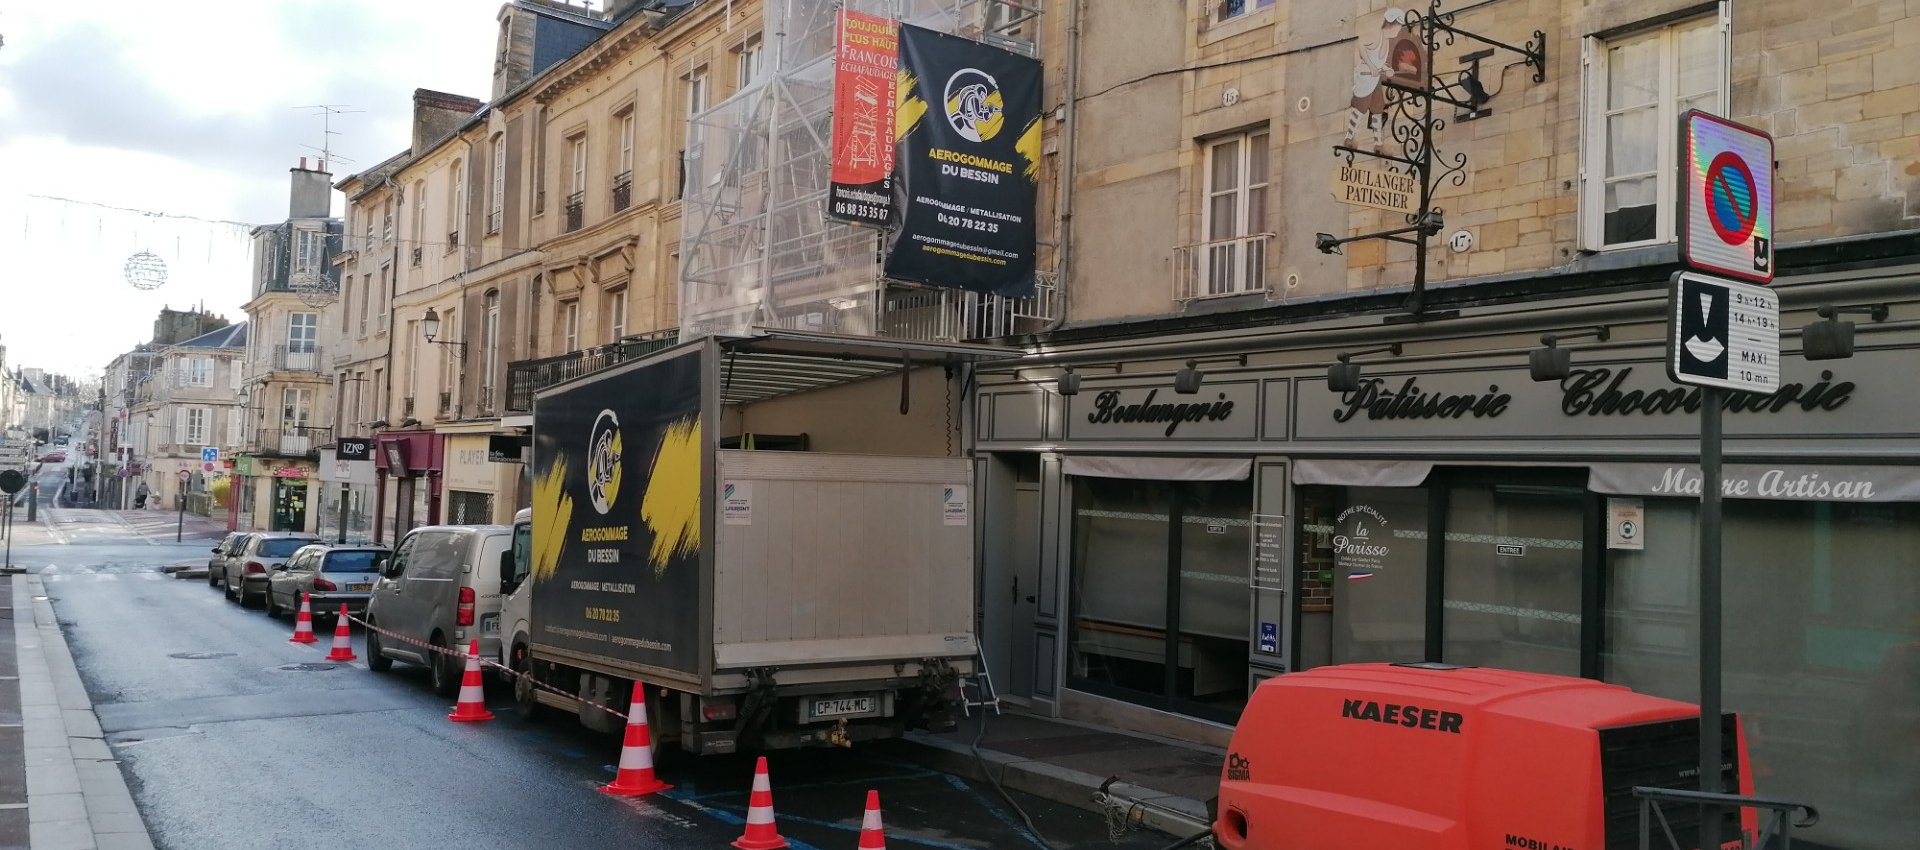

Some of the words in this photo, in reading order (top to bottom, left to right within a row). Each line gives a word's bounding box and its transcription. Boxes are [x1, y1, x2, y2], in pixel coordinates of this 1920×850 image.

[844, 32, 869, 45] PLUS
[872, 37, 898, 51] HAUT
[840, 62, 897, 80] ECHAFAUDAGES
[883, 80, 896, 189] ECHAFAUDAGES
[928, 148, 1013, 174] AEROGOMMAGE
[942, 164, 959, 176] DU
[960, 167, 999, 185] BESSIN
[1340, 166, 1414, 194] BOULANGER
[1346, 185, 1408, 210] PATISSIER
[835, 201, 846, 214] 06
[847, 203, 857, 216] 88
[857, 204, 868, 217] 35
[868, 206, 878, 219] 35
[879, 208, 888, 220] 87
[970, 207, 1022, 223] METALLISATION
[948, 215, 960, 227] 20
[961, 218, 973, 229] 78
[974, 221, 986, 232] 22
[987, 222, 999, 234] 35
[1741, 350, 1767, 365] MAXI
[1740, 370, 1752, 381] 10
[1754, 374, 1769, 384] mn
[1087, 389, 1235, 438] Boulangerie
[1560, 366, 1855, 416] Chocoerie
[460, 449, 484, 466] PLAYER
[1651, 467, 1748, 496] Mare
[1757, 469, 1876, 499] Artisan
[1337, 505, 1356, 523] NOTRE
[582, 526, 628, 542] AEROGOMMAGE
[1356, 521, 1369, 536] la
[1333, 535, 1389, 556] Parisse
[588, 549, 597, 563] DU
[597, 548, 619, 563] BESSIN
[571, 580, 600, 591] AEROGOMMAGE
[602, 582, 635, 594] METALLISATION
[592, 608, 599, 620] 20
[599, 608, 606, 621] 78
[606, 609, 613, 622] 22
[613, 610, 620, 623] 35
[817, 698, 867, 715] CP-744-MC
[1342, 698, 1464, 734] KAESER
[1227, 768, 1251, 781] SIGMA
[1505, 834, 1575, 850] MOBIL
